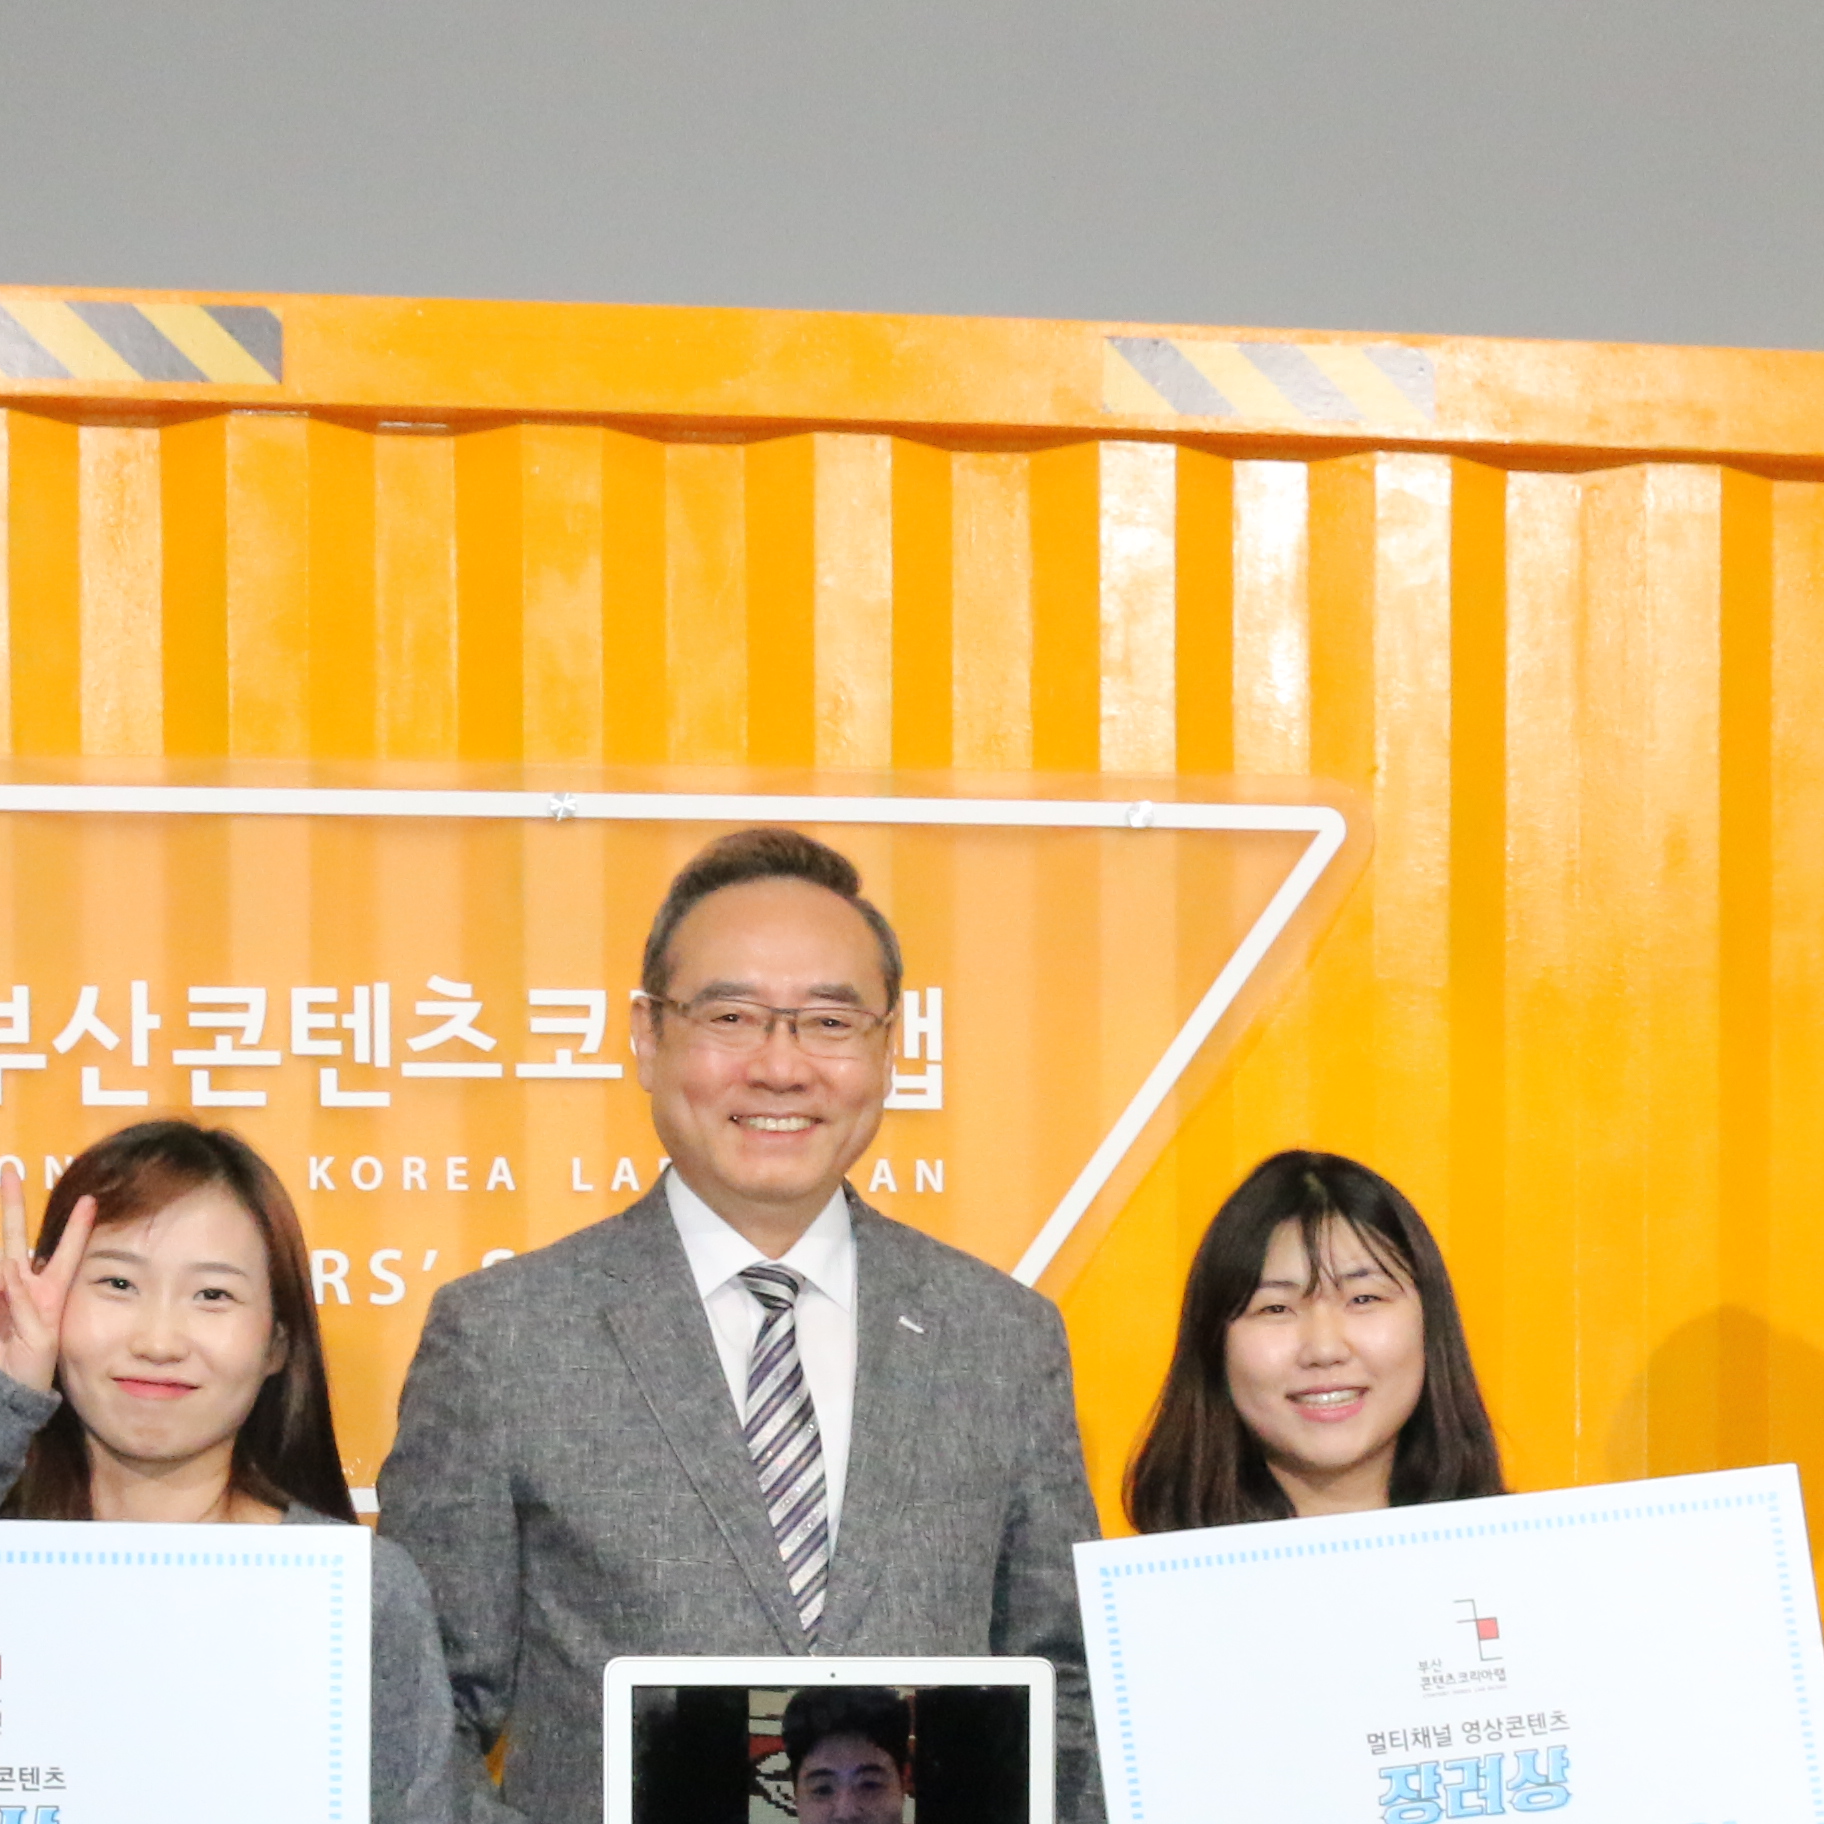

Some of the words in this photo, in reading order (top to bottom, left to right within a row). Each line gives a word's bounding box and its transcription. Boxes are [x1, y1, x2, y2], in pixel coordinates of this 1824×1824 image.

[308, 1156, 515, 1192] KOREA
[1418, 1658, 1442, 1674] 부산
[1367, 1723, 1453, 1756] 멀티채널
[1461, 1710, 1571, 1745] 영상콘텐츠
